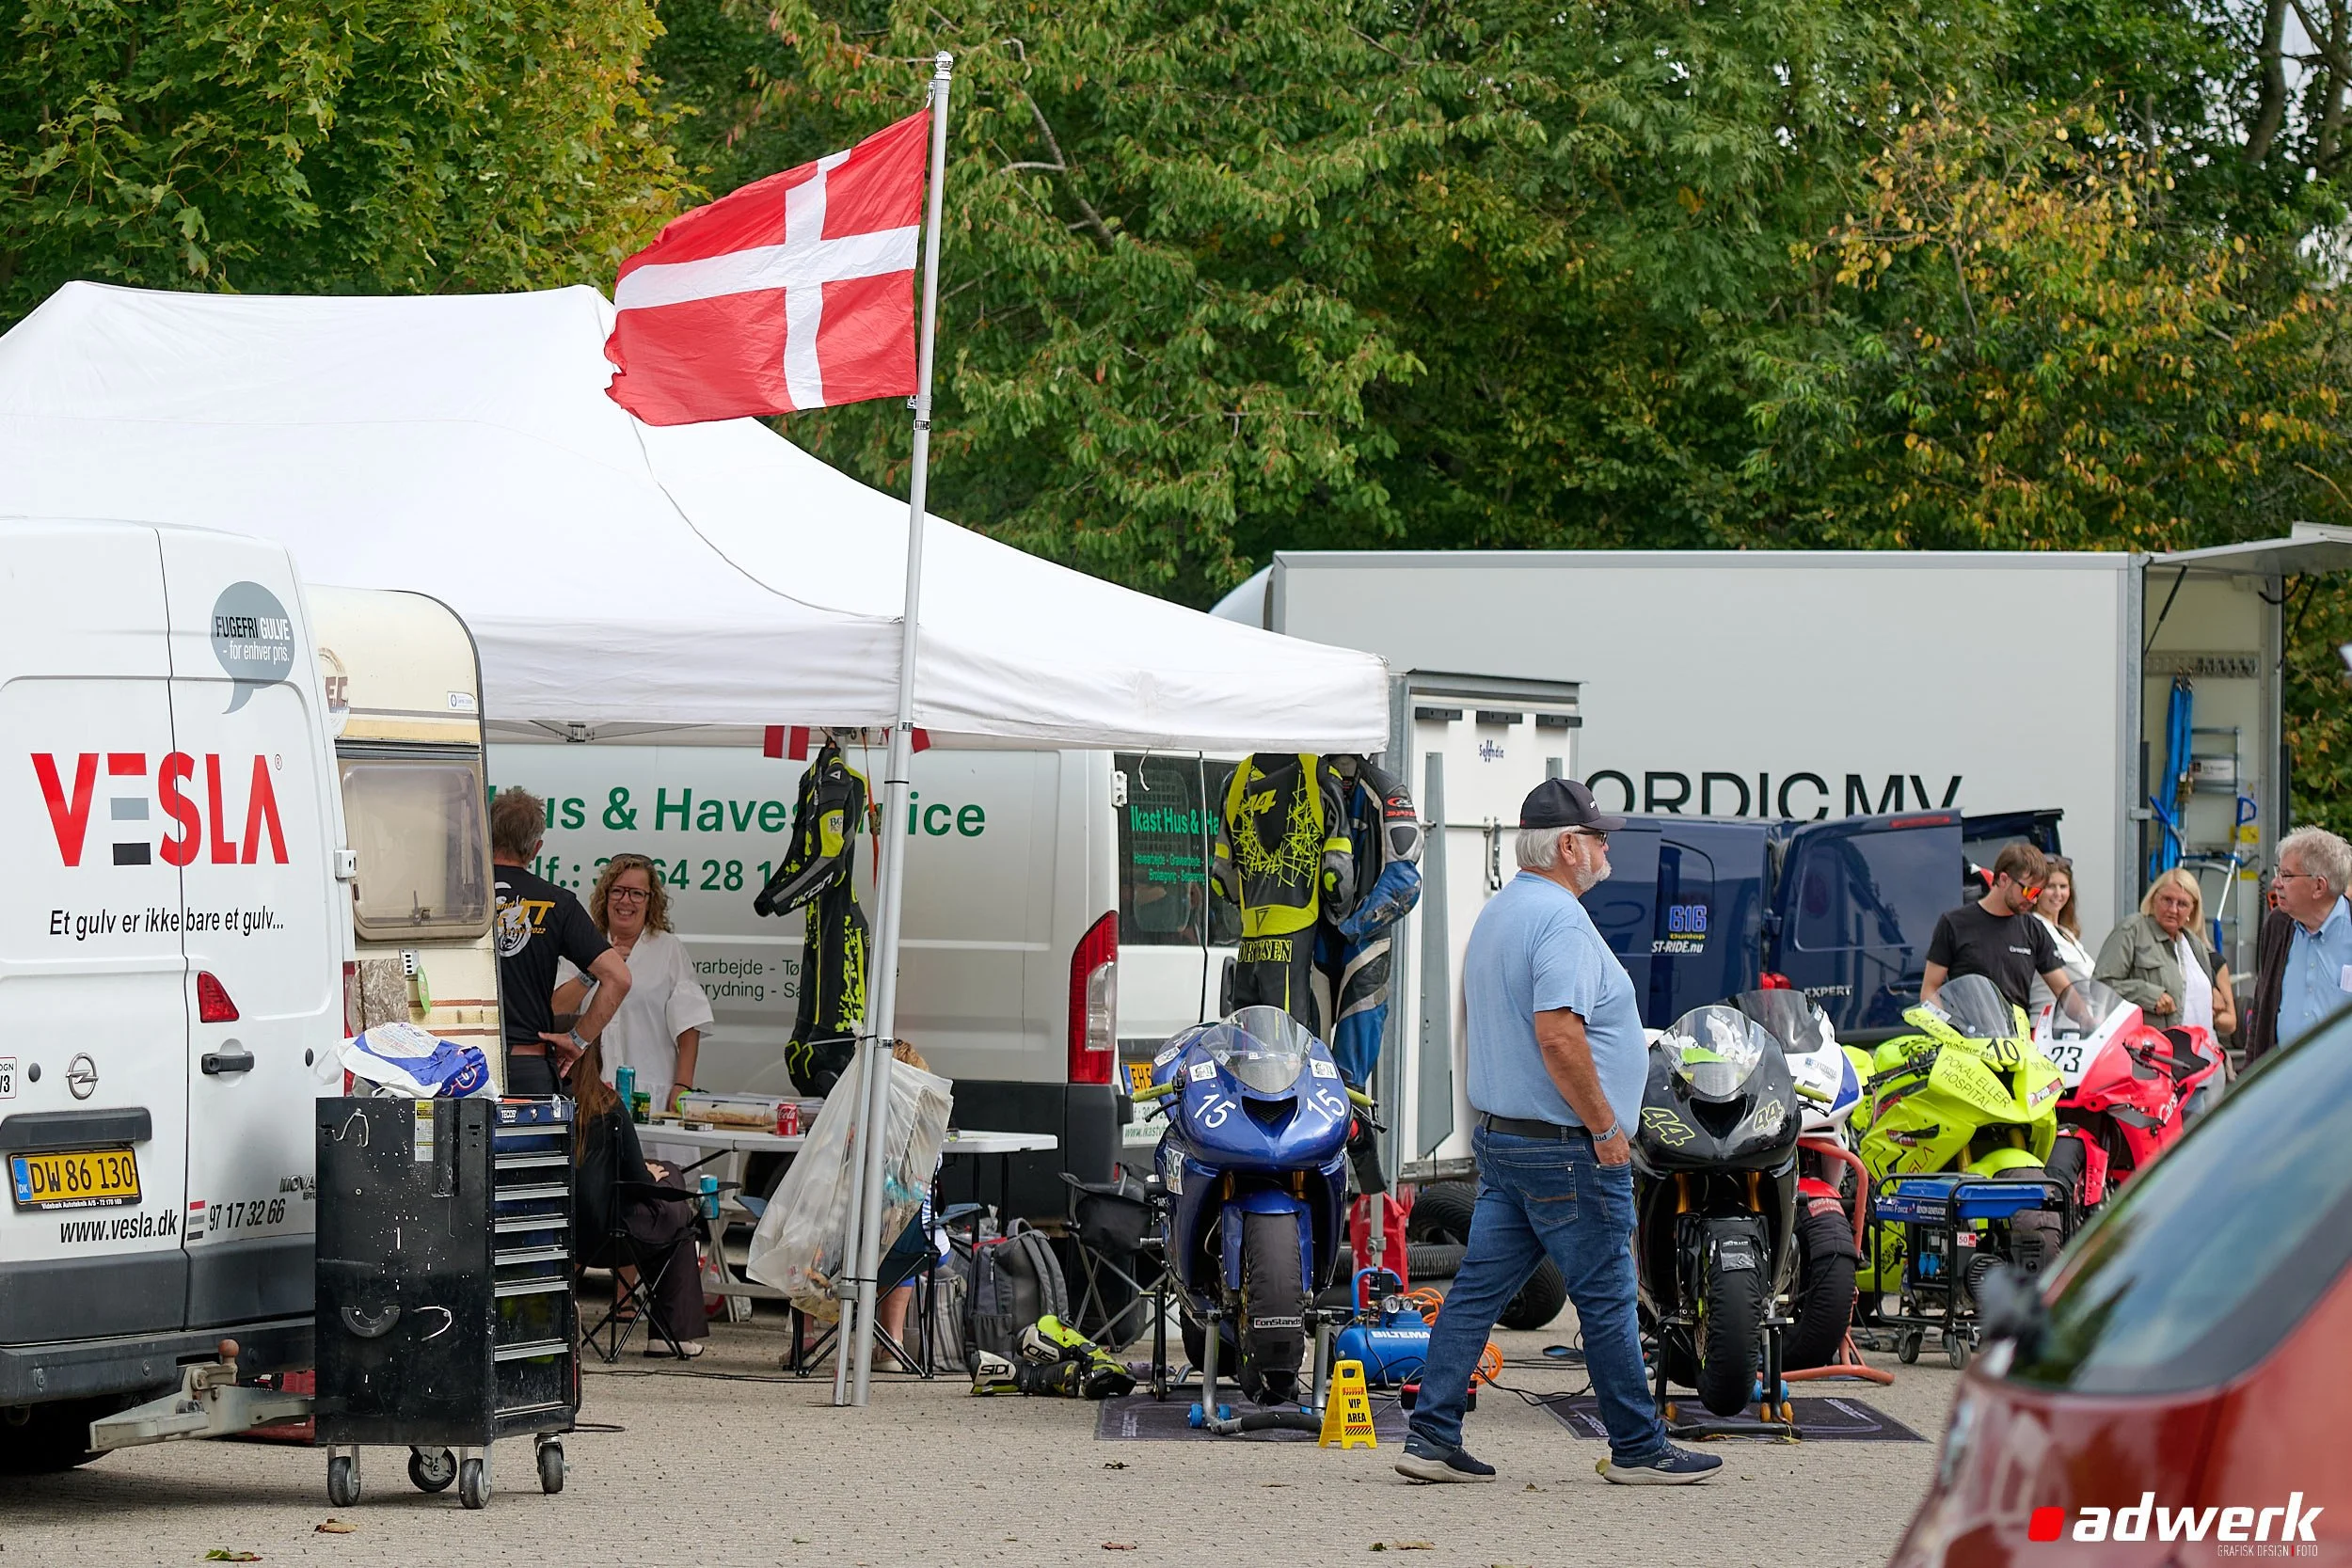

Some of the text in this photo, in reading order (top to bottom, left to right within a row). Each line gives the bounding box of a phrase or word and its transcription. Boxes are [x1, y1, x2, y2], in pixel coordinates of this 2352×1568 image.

[215, 615, 291, 641] FUGEFRI GULVE
[229, 641, 242, 661] for
[243, 642, 272, 661] enhver
[273, 643, 290, 664] pris.
[31, 752, 290, 866] VESLA
[602, 786, 638, 831] &
[1846, 773, 1963, 817] MV
[1130, 805, 1162, 832] Ikast
[1163, 807, 1188, 833] Hus
[1190, 809, 1200, 834] &
[700, 860, 743, 891] 28
[49, 906, 285, 941] Et gulv er ikke bare et gulv...
[1669, 905, 1708, 932] 616
[1804, 985, 1853, 998] EXPERT
[1986, 1038, 2021, 1062] 10
[1941, 1069, 1992, 1111] HOSPITAL
[1943, 1054, 2010, 1108] POKAL ELLER
[1194, 1092, 1236, 1129] 15
[1307, 1086, 1345, 1123] 15
[1753, 1100, 1786, 1132] 44
[1641, 1106, 1696, 1147] 44
[19, 1156, 135, 1195] DK DW 86 130
[60, 1210, 178, 1243] www.vesla.dk
[209, 1198, 286, 1231] 97 17 32 66
[1958, 1235, 1968, 1244] 50
[1371, 1331, 1431, 1339] BILTEMA
[1347, 1413, 1366, 1423] AREA
[1348, 1399, 1361, 1409] VIP
